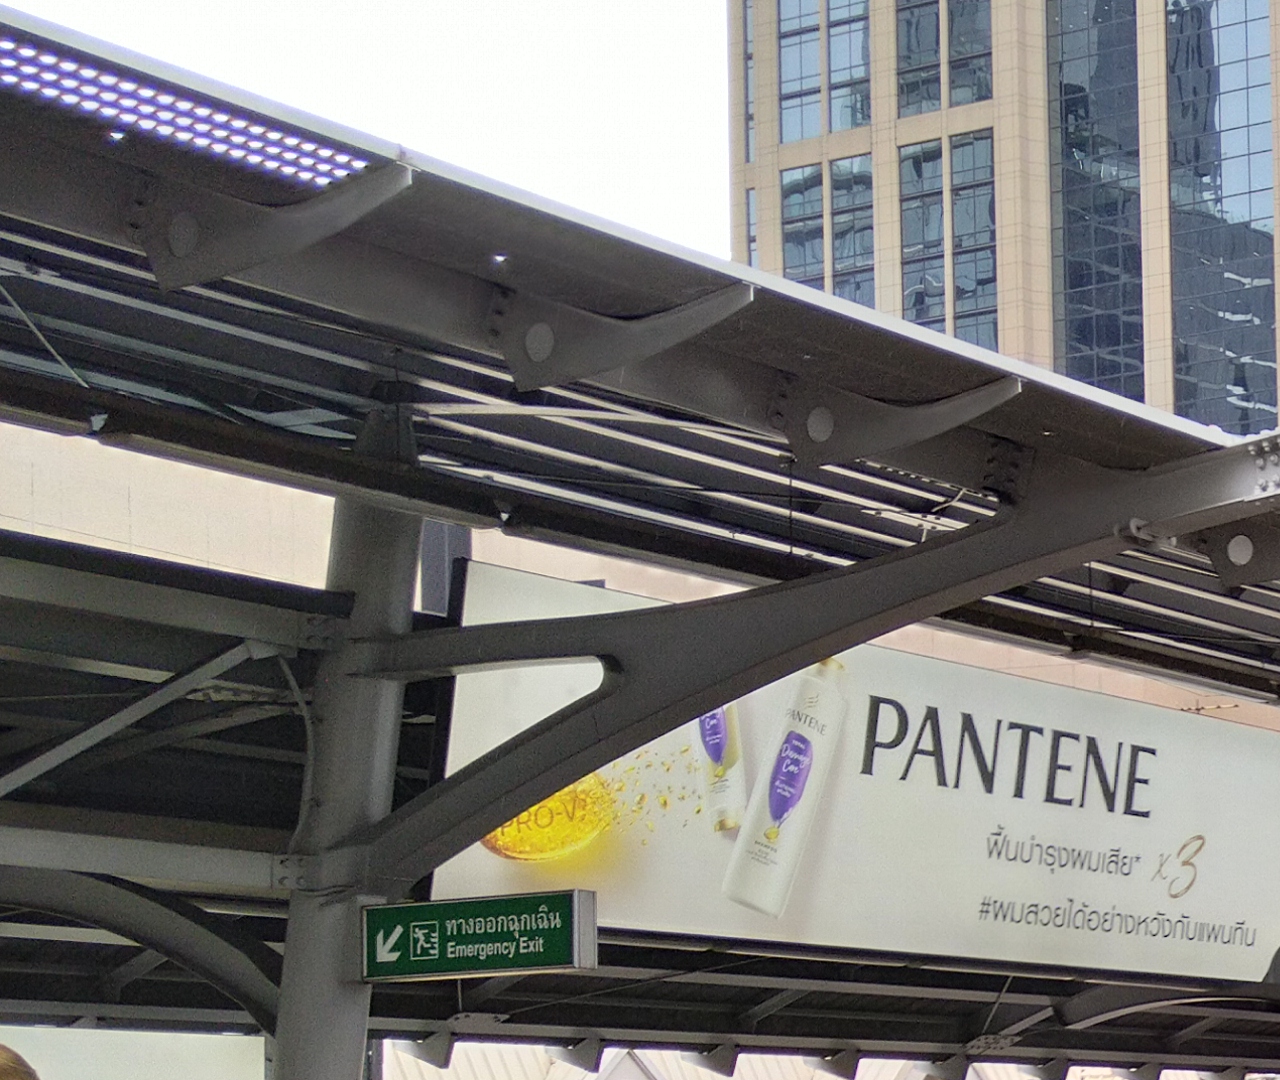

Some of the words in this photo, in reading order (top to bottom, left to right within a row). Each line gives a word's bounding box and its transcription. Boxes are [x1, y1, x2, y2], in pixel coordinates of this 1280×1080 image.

[786, 708, 828, 736] PANTENE
[859, 694, 1158, 818] PANTENE
[446, 904, 561, 940] ทางออกฉุกเฉิน
[447, 939, 517, 960] Emergency
[519, 936, 544, 954] Exit
